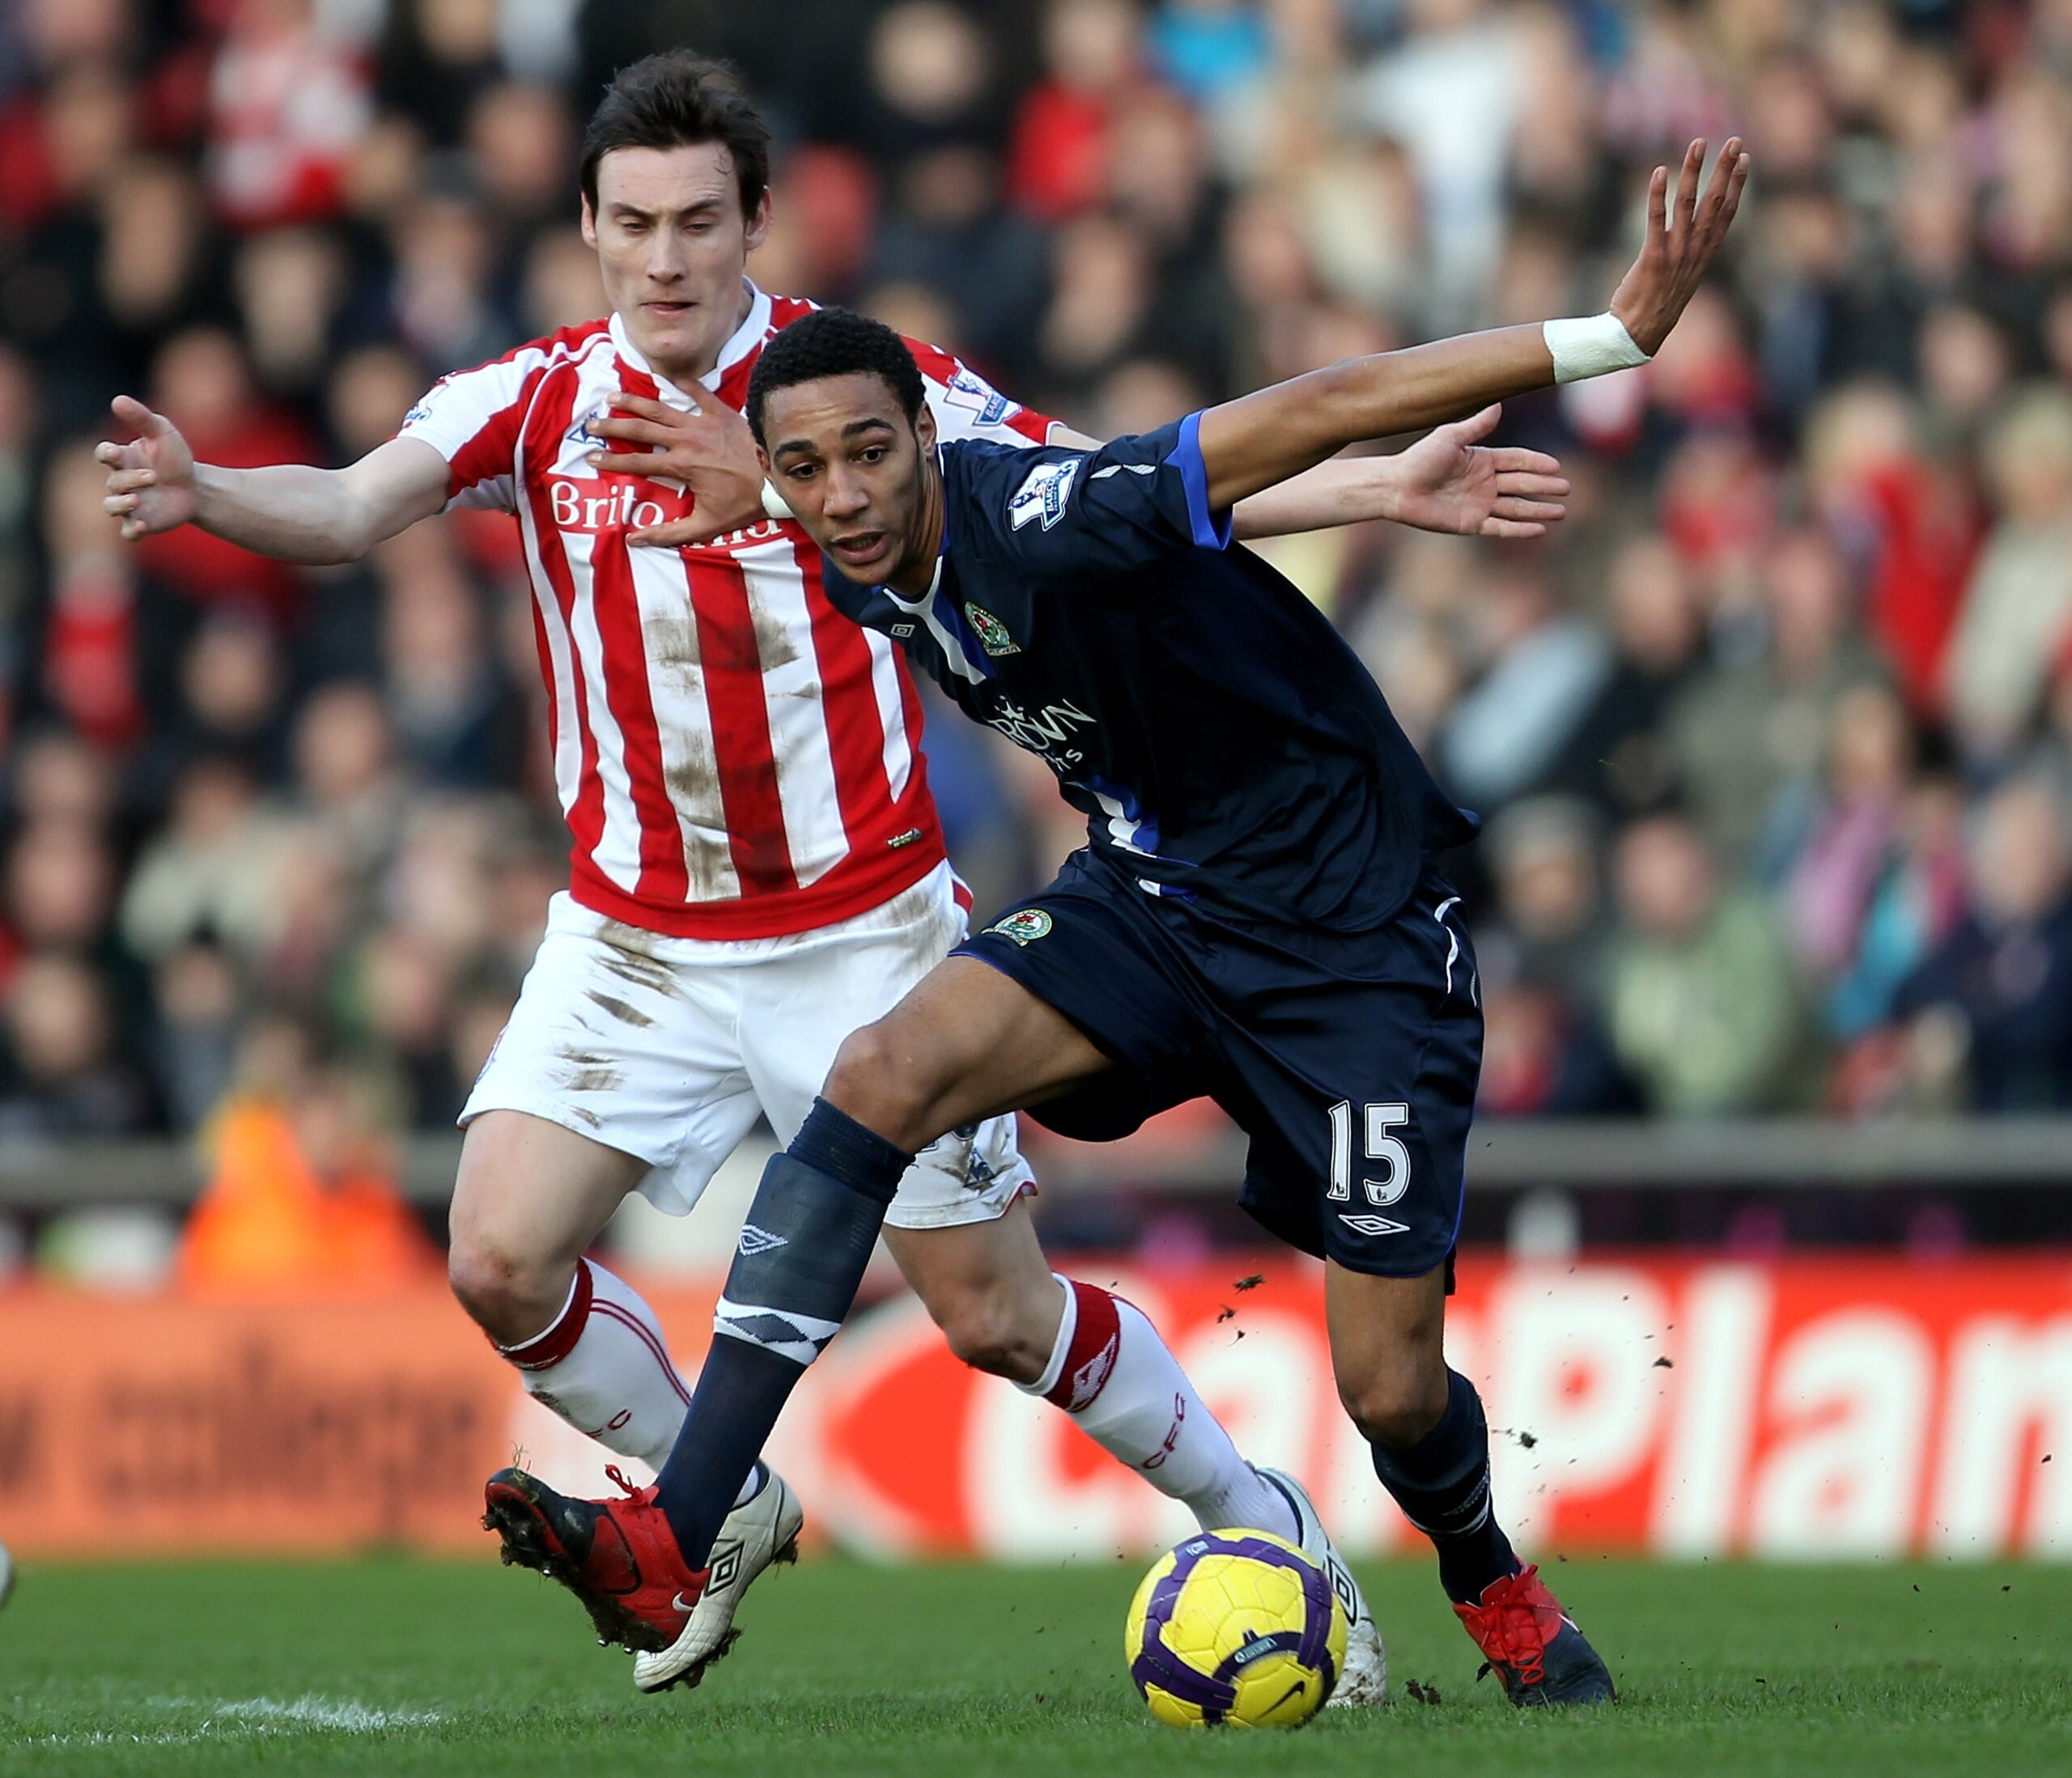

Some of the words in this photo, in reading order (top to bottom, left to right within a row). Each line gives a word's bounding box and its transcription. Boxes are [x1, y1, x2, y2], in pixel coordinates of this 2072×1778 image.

[987, 698, 1097, 749] ROWN
[1327, 1099, 1411, 1206] 15
[962, 1261, 2072, 1562] CaPlan
[1140, 1390, 1186, 1470] CFC
